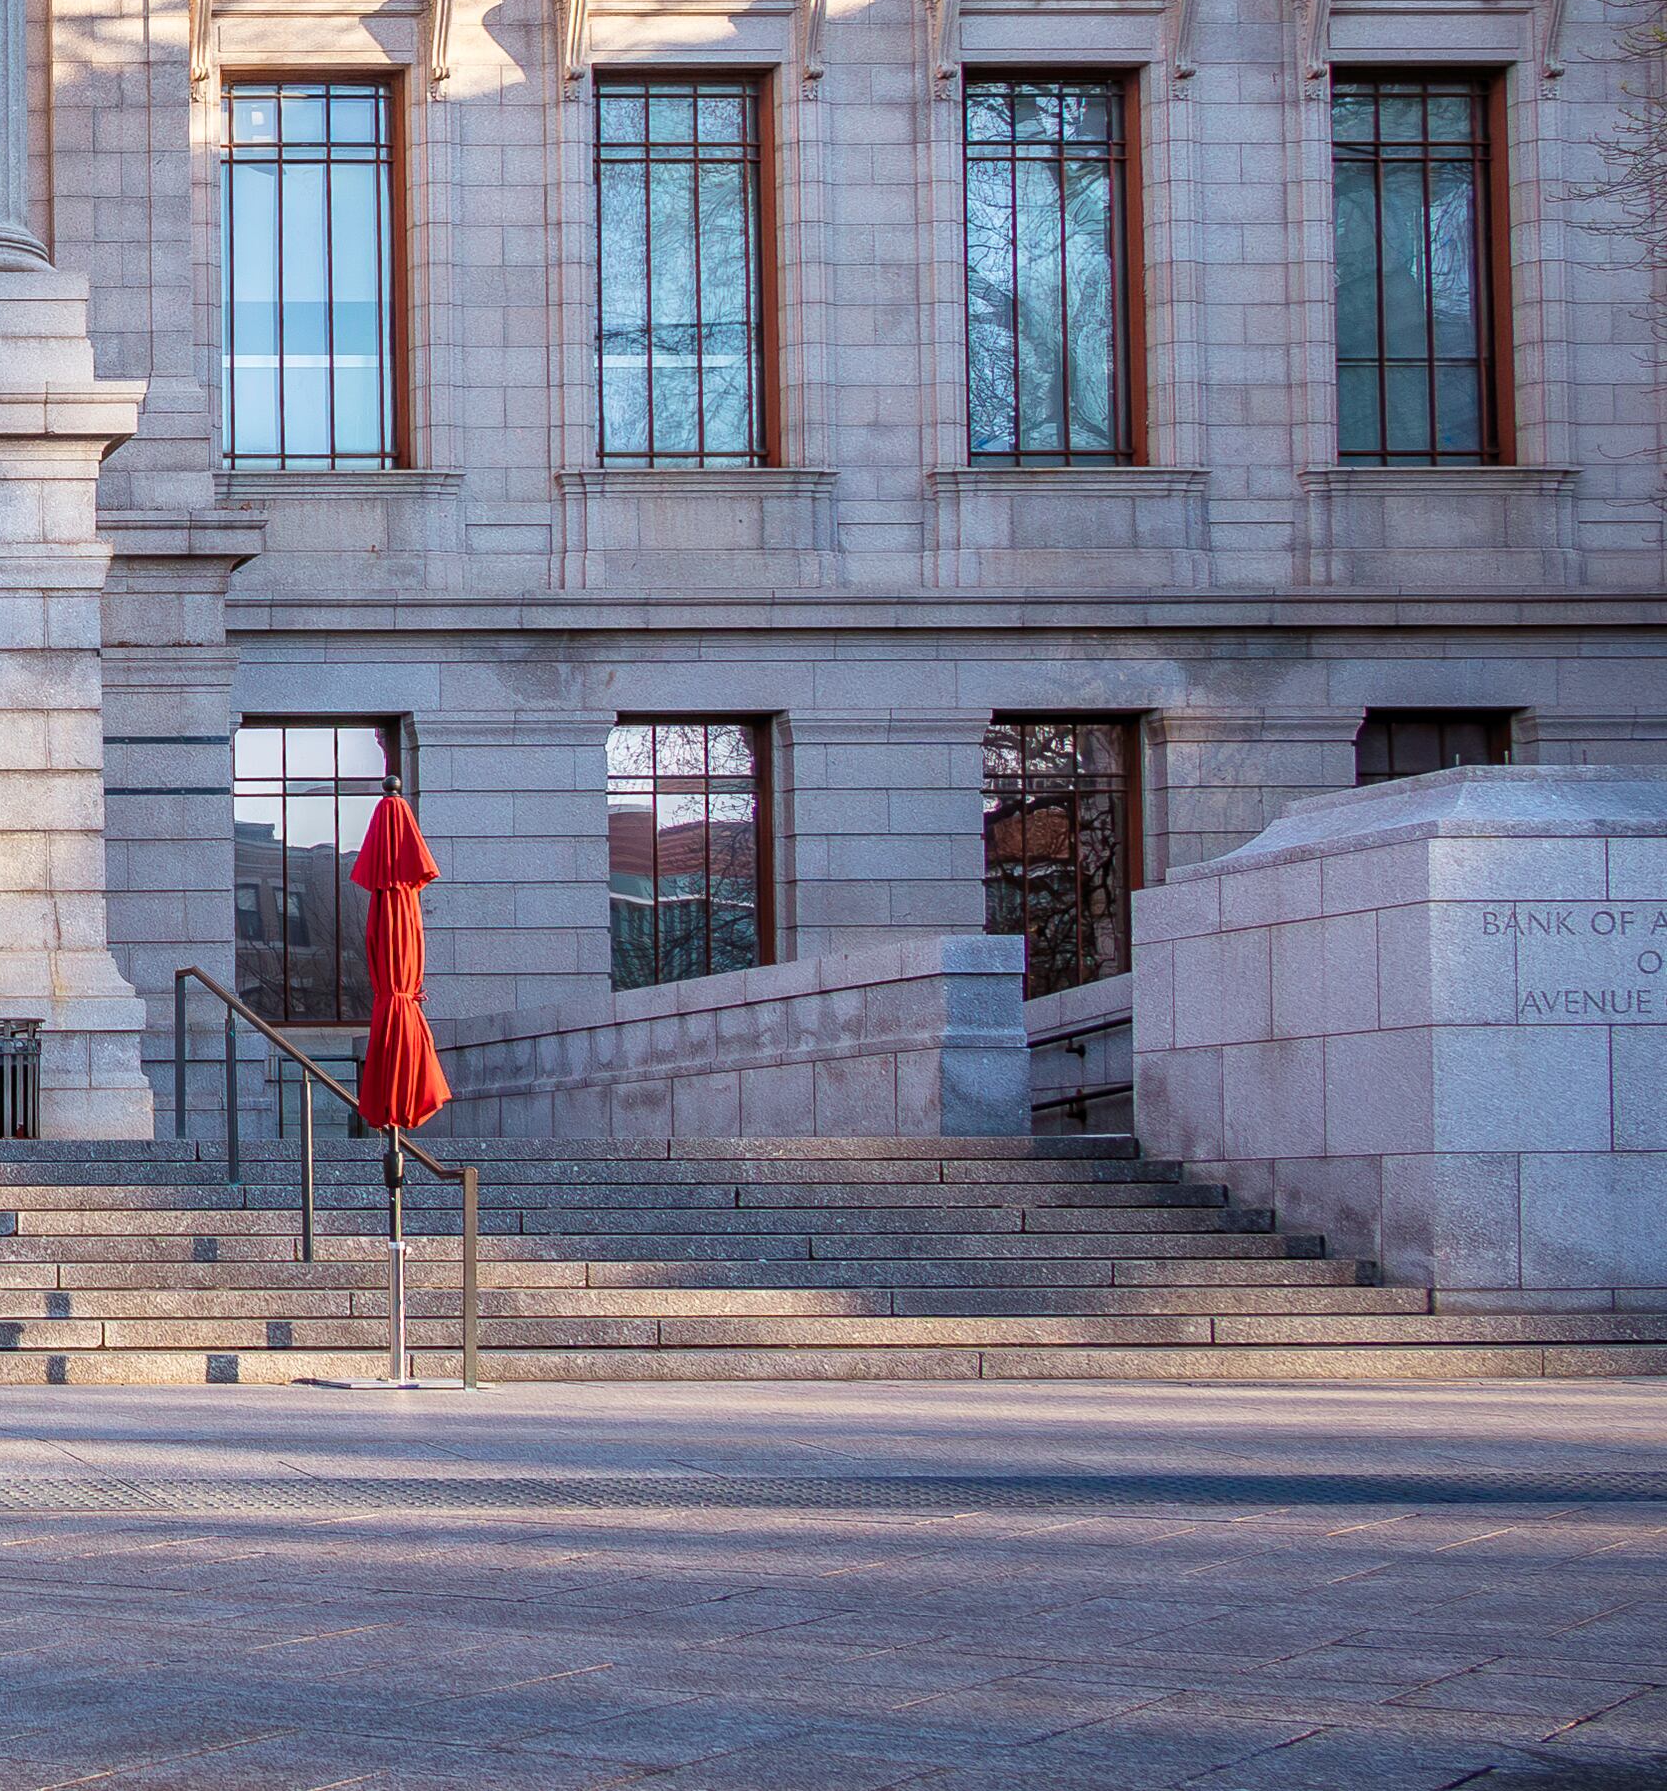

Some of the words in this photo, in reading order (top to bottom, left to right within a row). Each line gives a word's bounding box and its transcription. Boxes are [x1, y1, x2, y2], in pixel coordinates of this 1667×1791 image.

[1482, 910, 1576, 936] BANK
[1590, 910, 1634, 936] OF
[1519, 989, 1652, 1015] AVENUE
